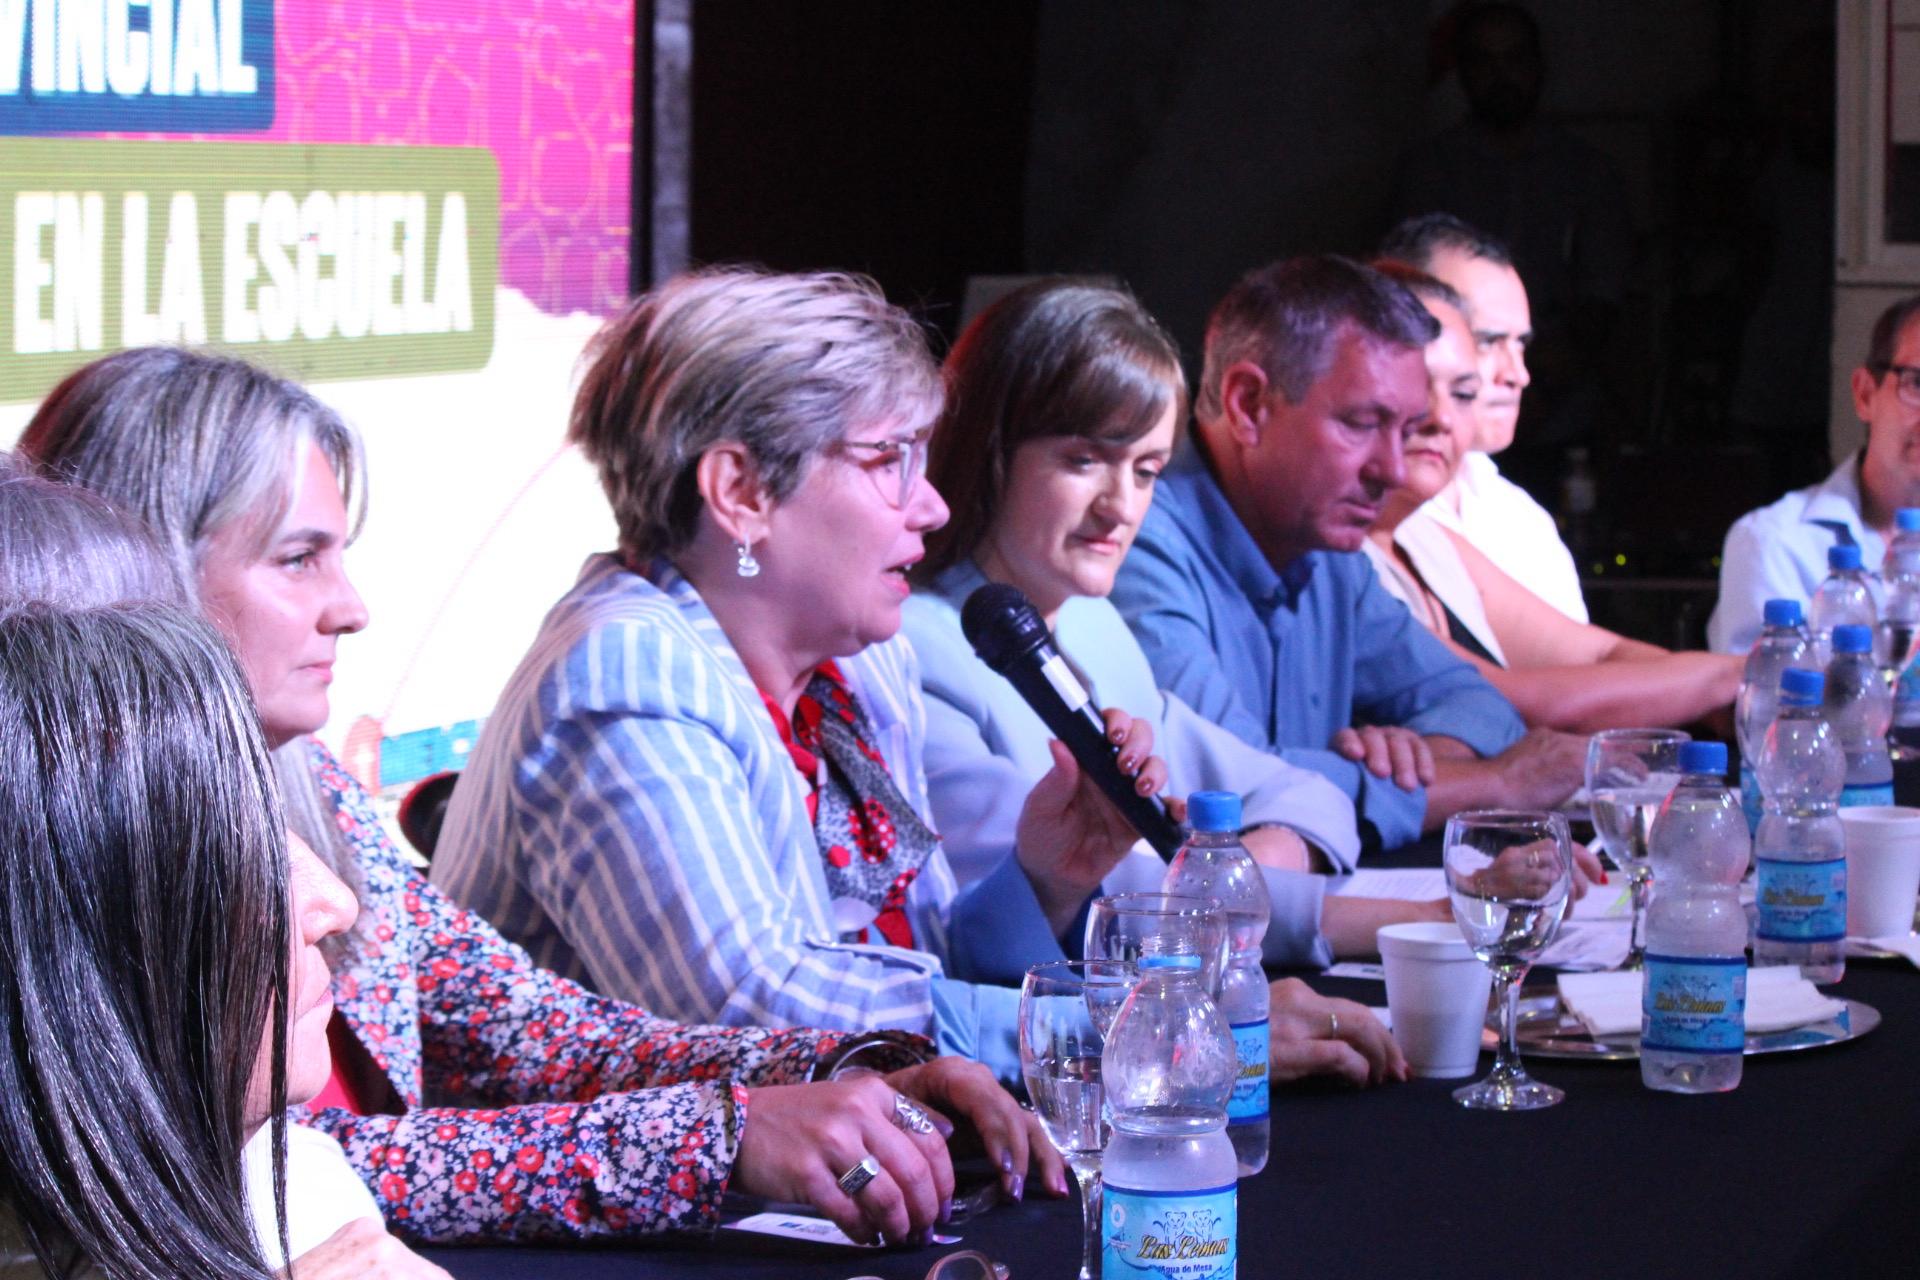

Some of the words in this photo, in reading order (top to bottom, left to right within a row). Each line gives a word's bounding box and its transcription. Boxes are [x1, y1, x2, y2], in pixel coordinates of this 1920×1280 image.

[14, 190, 104, 353] EN
[121, 190, 207, 347] LA
[222, 188, 473, 343] ESCUELA
[1137, 1235, 1175, 1260] Las
[1182, 1264, 1191, 1273] de
